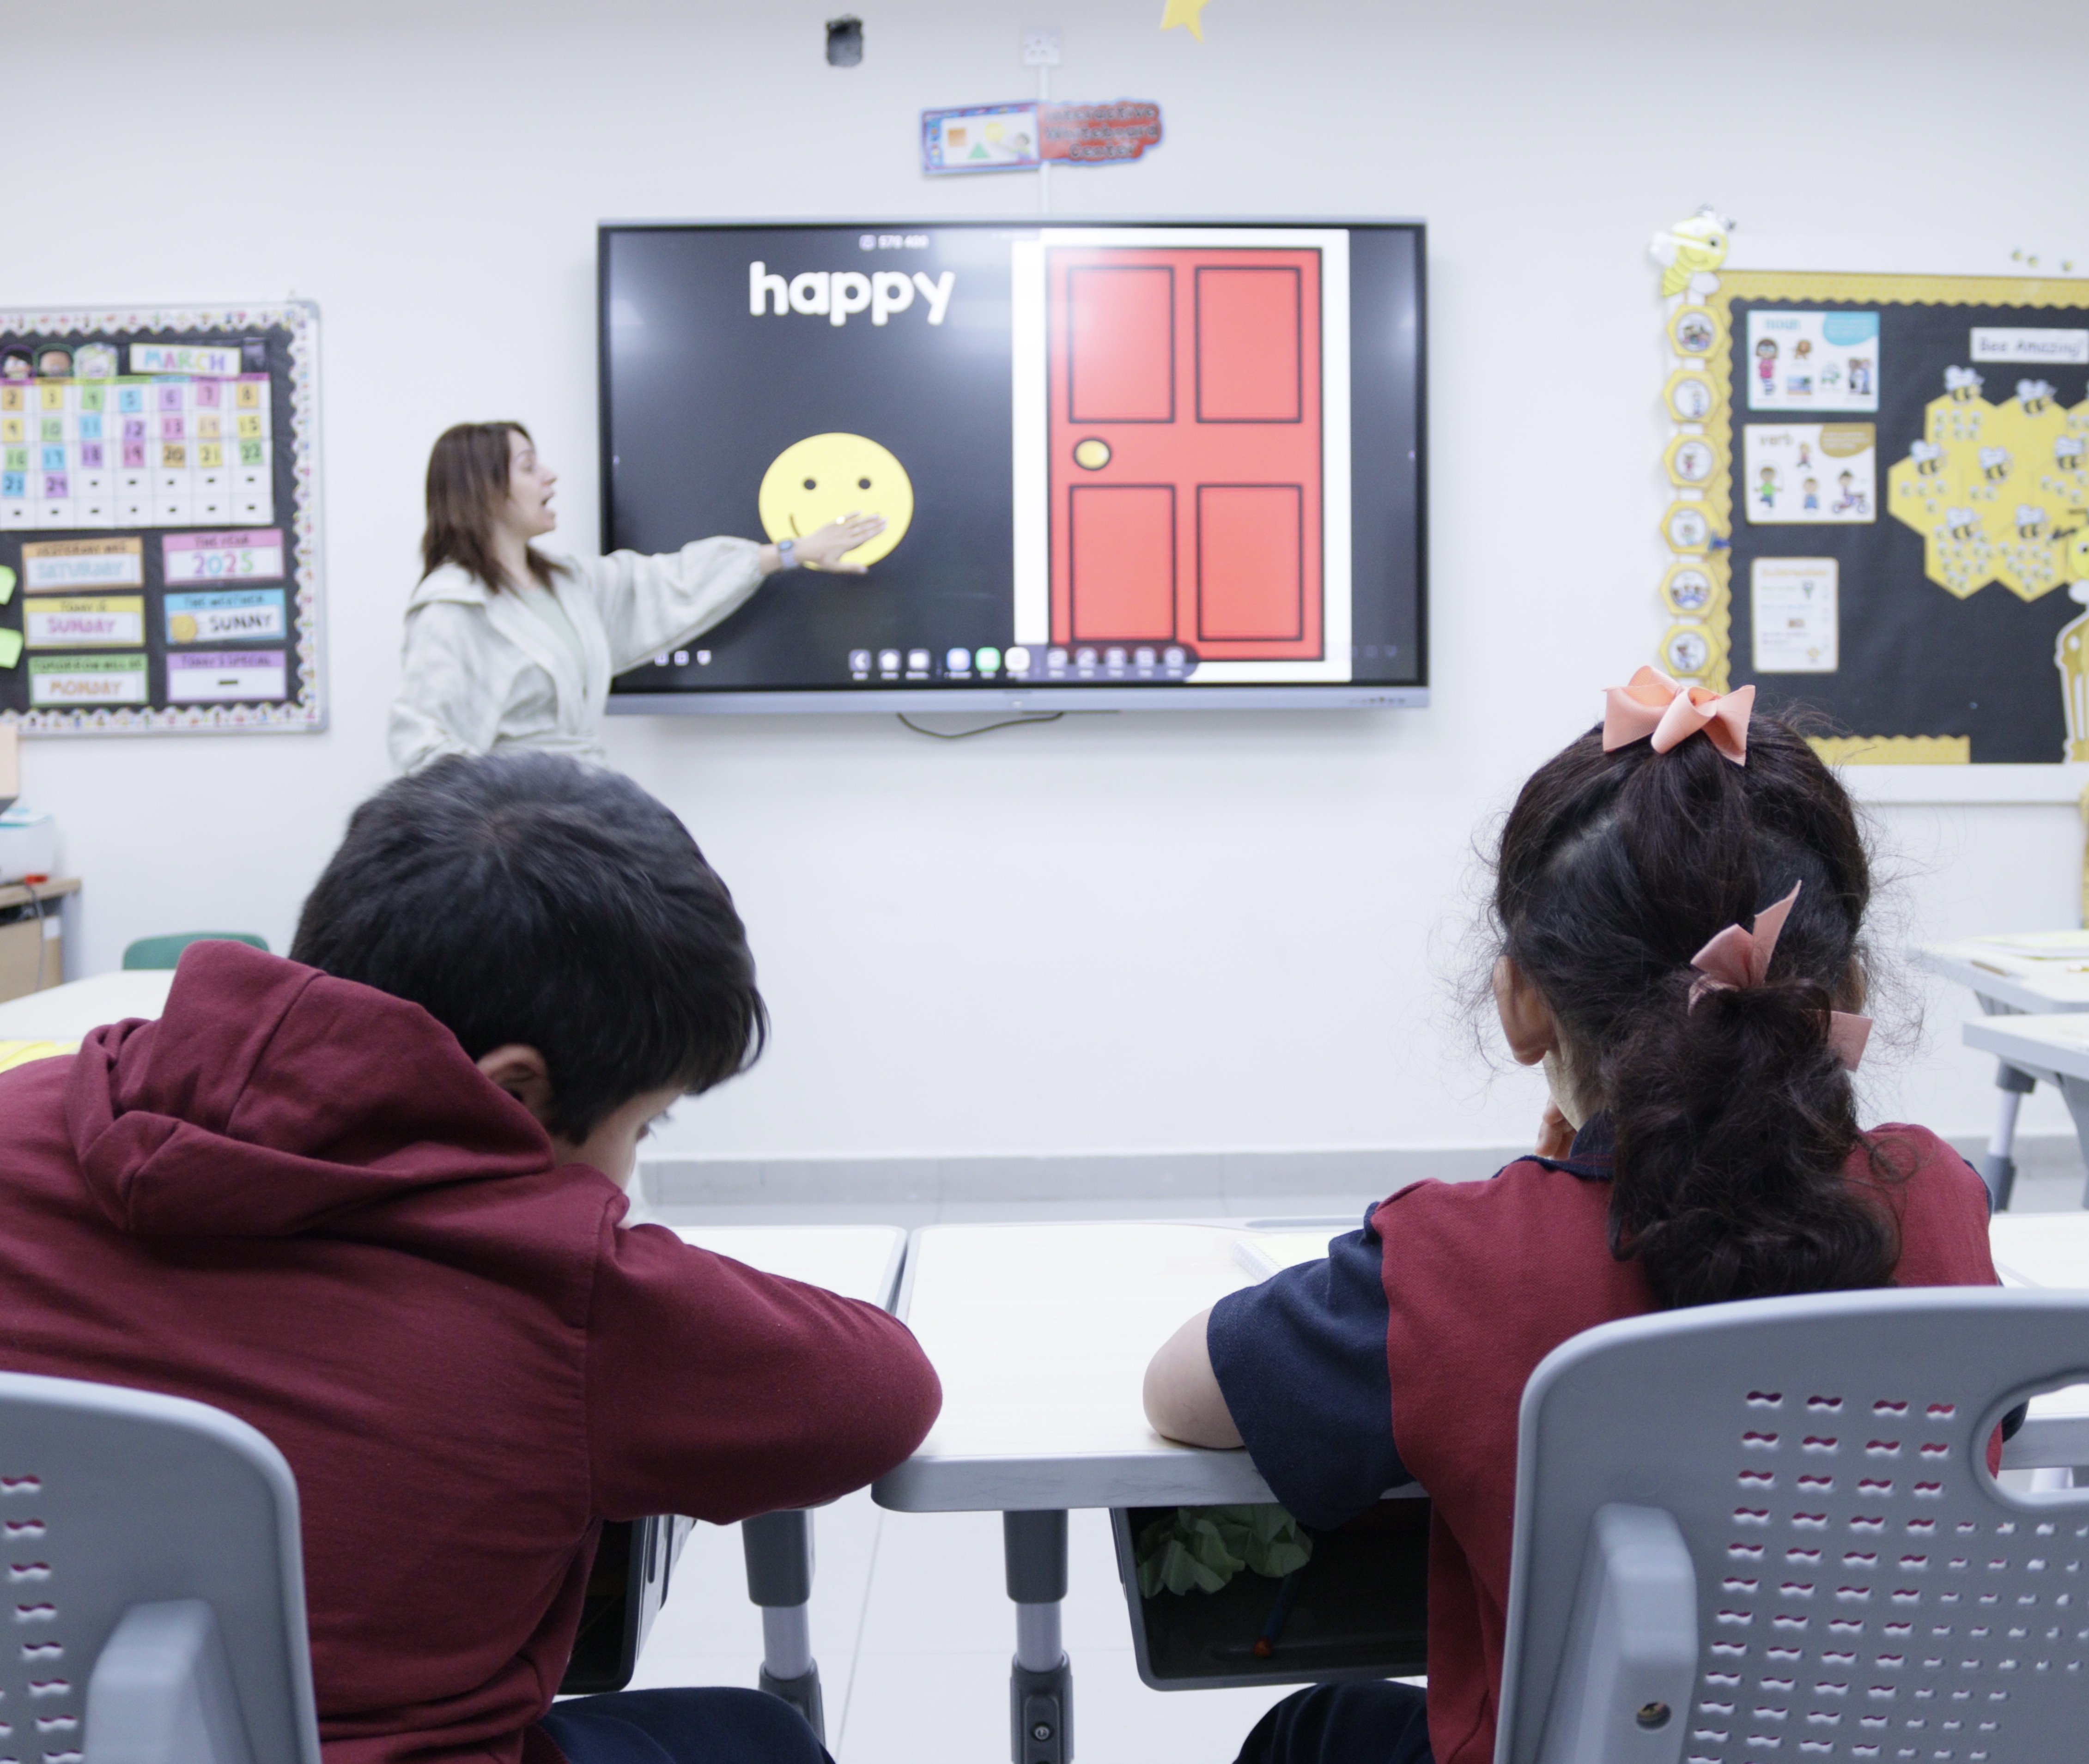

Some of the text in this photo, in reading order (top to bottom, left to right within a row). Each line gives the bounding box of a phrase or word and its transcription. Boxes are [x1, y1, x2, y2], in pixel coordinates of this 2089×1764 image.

[1069, 143, 1136, 158] Center
[749, 261, 956, 327] happy
[1980, 337, 2008, 351] Bee
[144, 348, 225, 371] MARCH
[7, 390, 16, 405] 2
[127, 391, 135, 406] 5
[204, 386, 213, 402] 7
[43, 422, 60, 436] 10
[83, 419, 100, 432] 11
[126, 421, 142, 436] 12
[241, 416, 258, 432] 15
[45, 448, 62, 463] 17
[164, 447, 183, 461] 20
[203, 447, 220, 461] 21
[243, 444, 262, 459] 22
[36, 560, 123, 578] SATURDAY
[192, 551, 254, 575] 2025
[47, 618, 116, 633] SUNDAY
[209, 612, 273, 632] SUNNY
[50, 680, 122, 696] MONDAY
